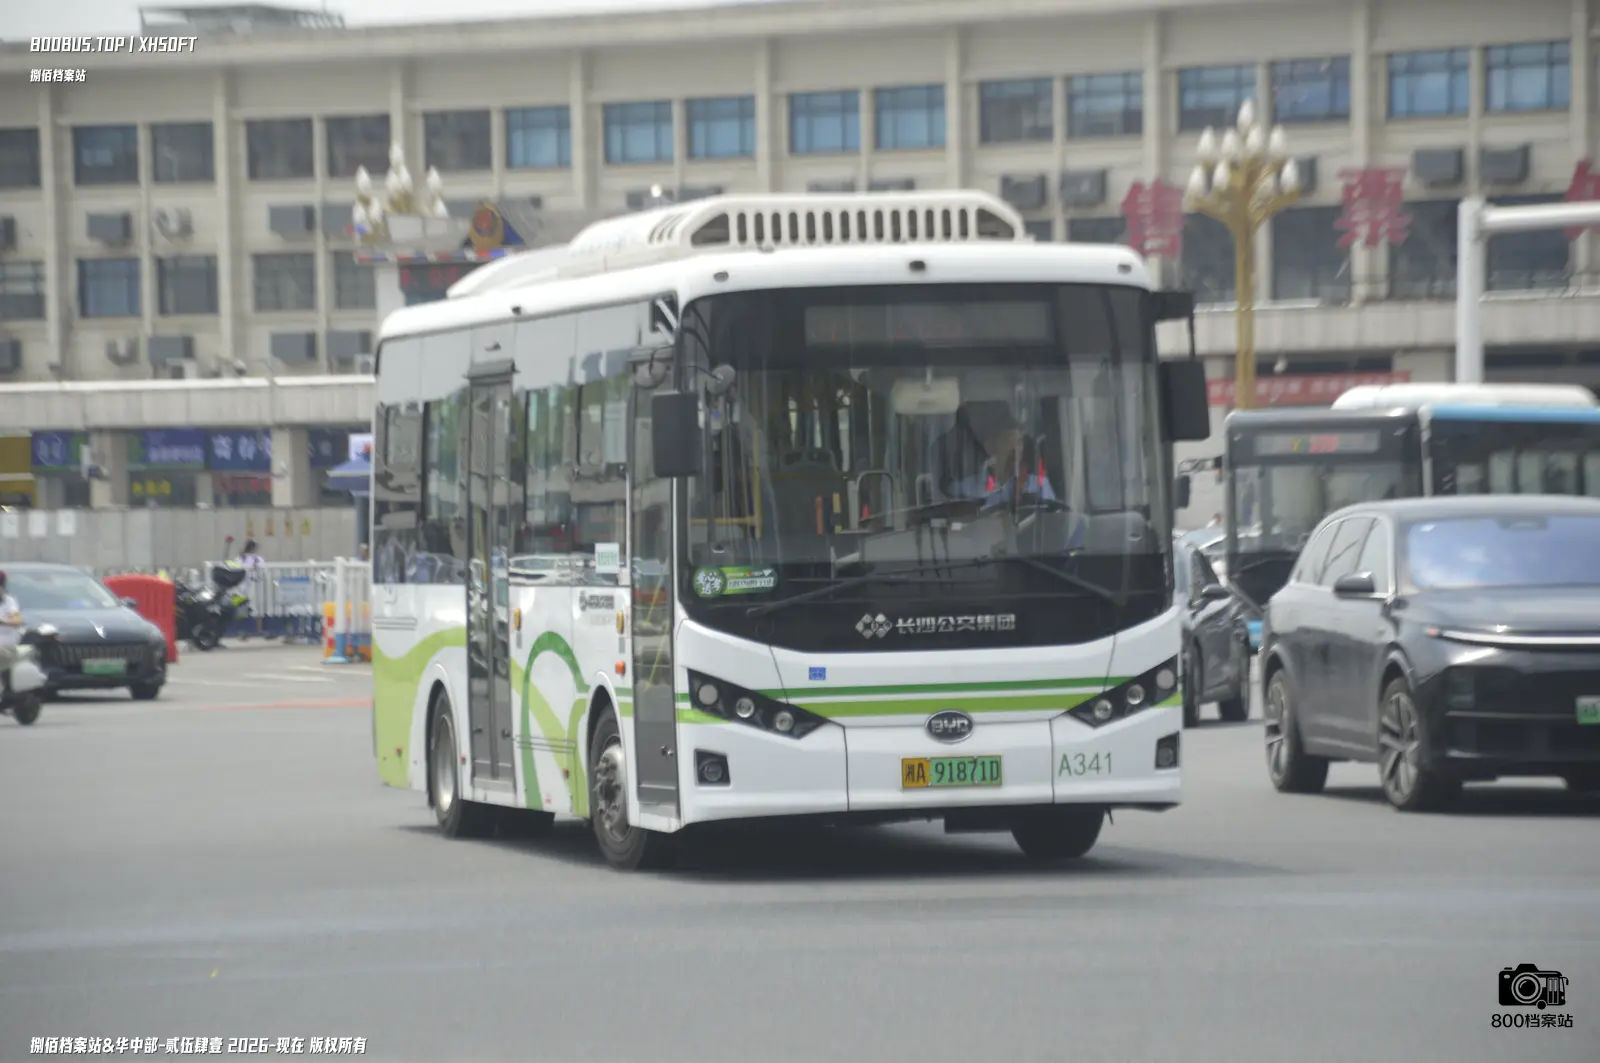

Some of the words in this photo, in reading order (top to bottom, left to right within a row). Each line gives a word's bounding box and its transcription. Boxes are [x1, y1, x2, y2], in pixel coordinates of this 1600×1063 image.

[896, 613, 1016, 634] 长沙公交集团
[931, 717, 969, 733] BYD
[1058, 752, 1113, 777] A341
